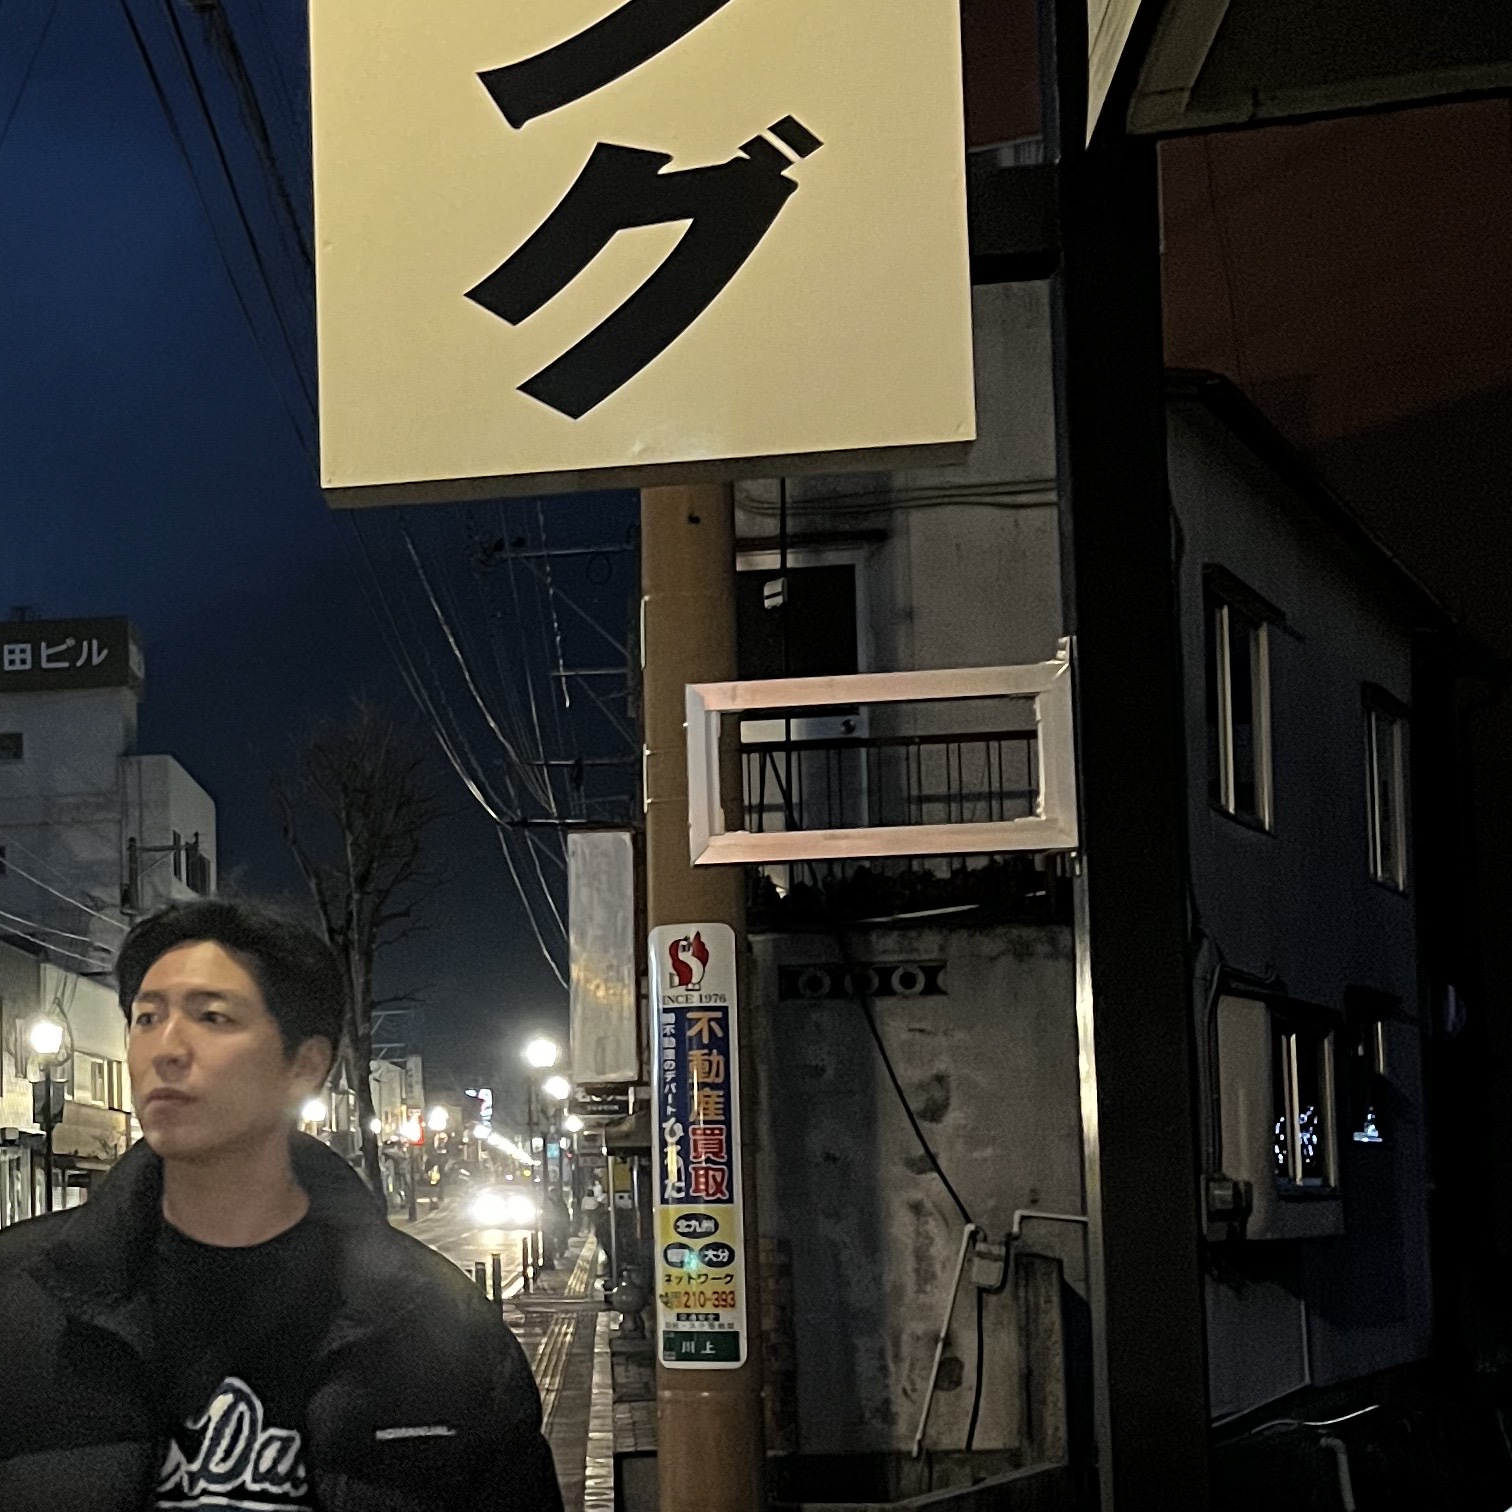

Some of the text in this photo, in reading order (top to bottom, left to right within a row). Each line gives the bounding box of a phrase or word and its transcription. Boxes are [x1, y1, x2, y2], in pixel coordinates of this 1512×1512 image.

[686, 1010, 730, 1200] 不動産買取
[704, 1248, 730, 1262] 大分
[681, 1340, 717, 1355] 川上
